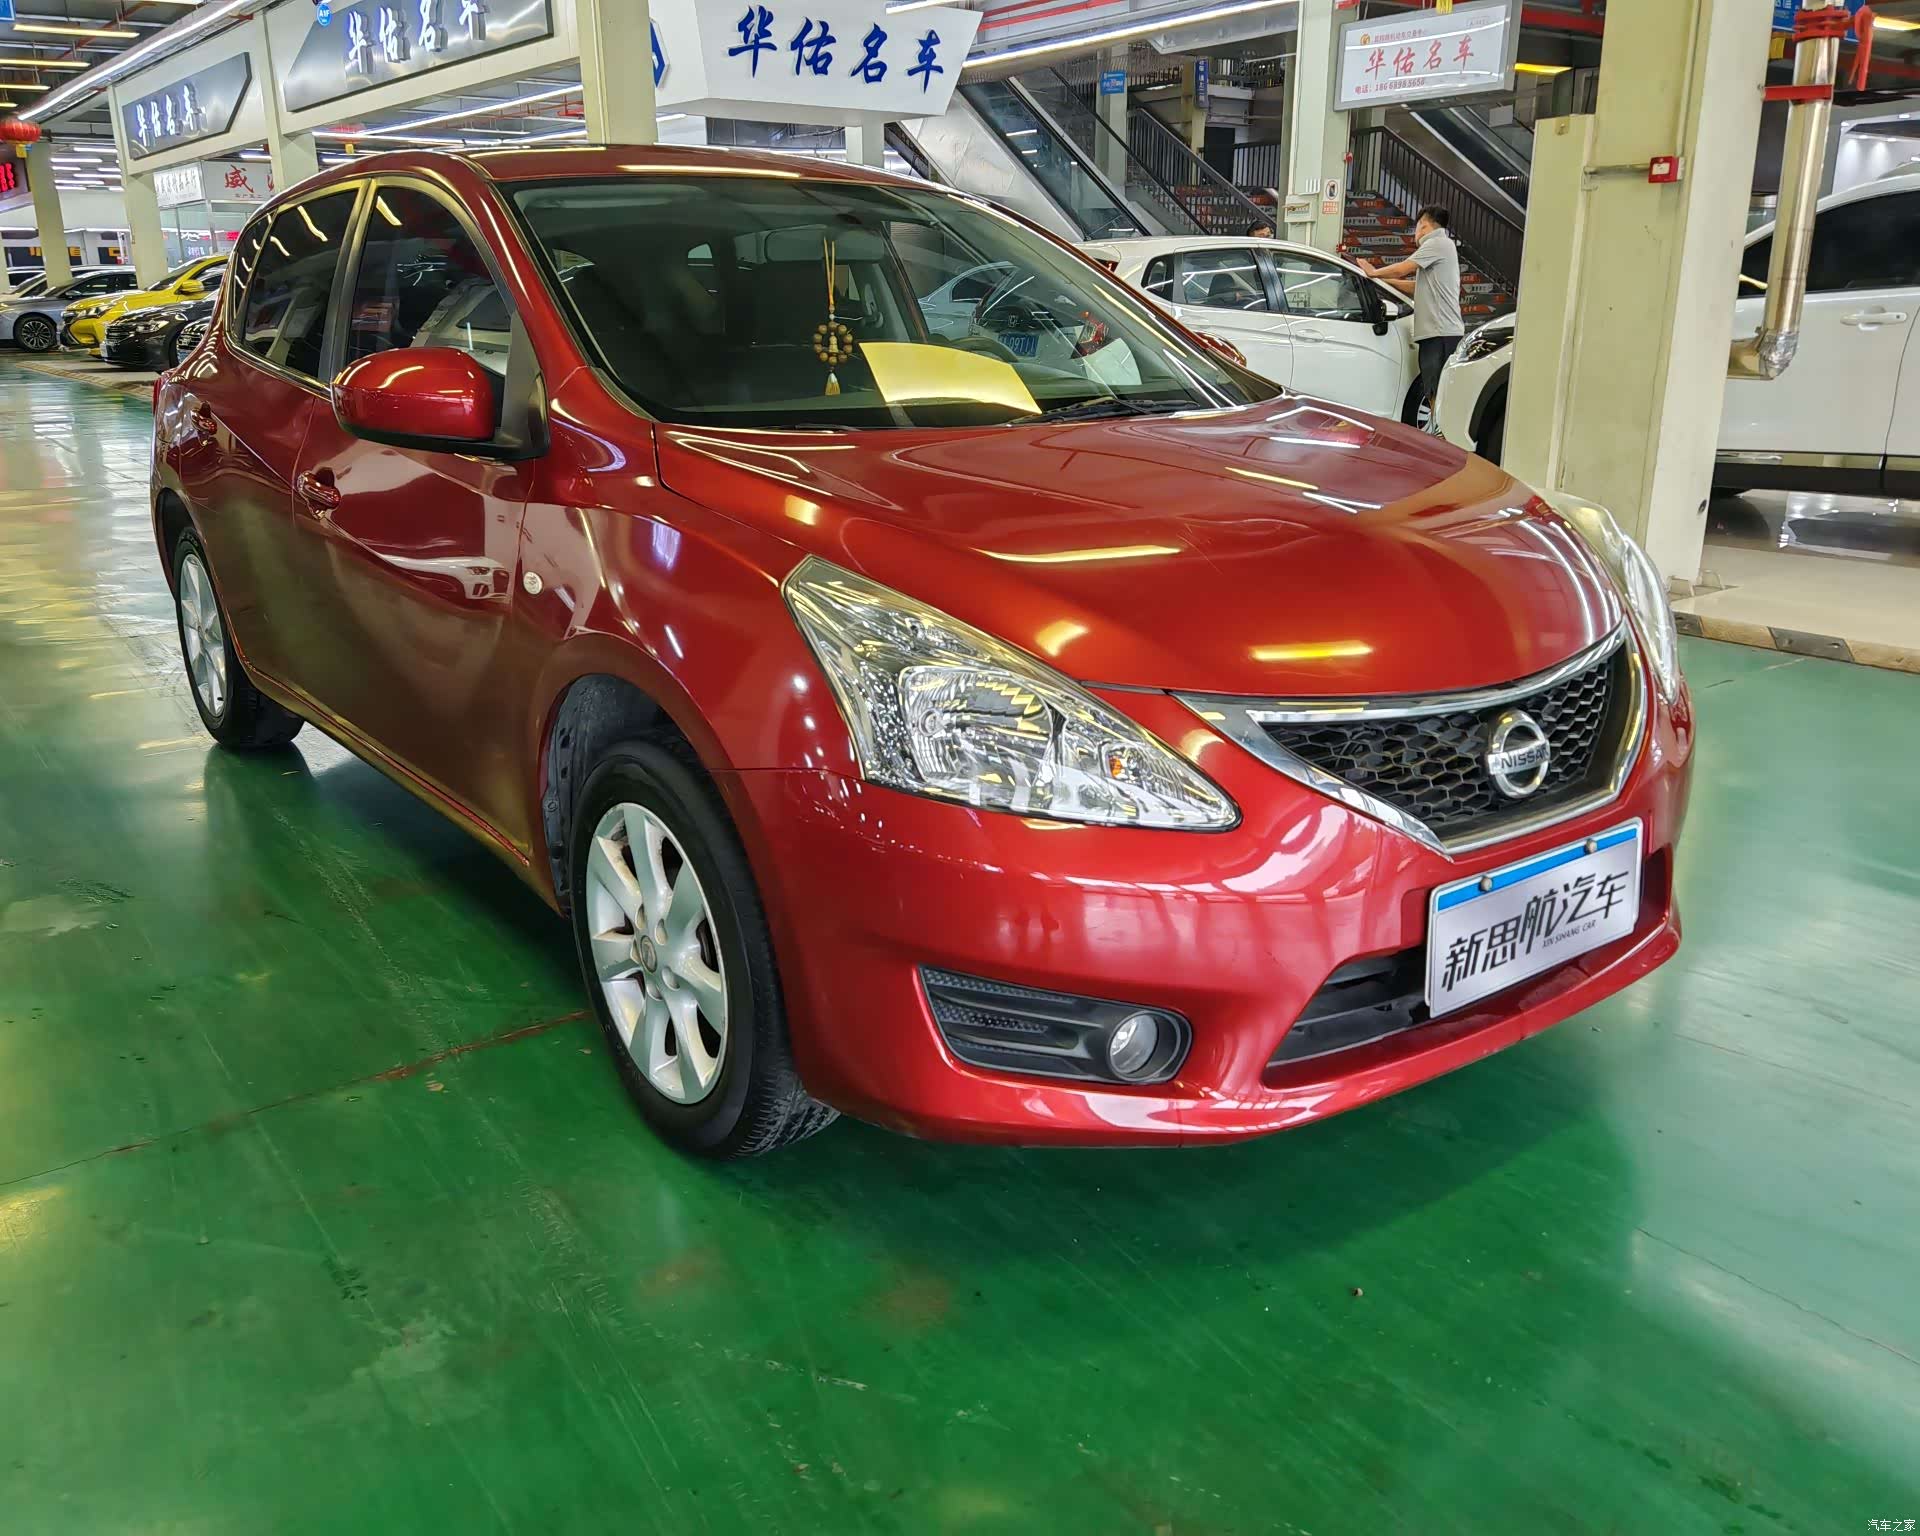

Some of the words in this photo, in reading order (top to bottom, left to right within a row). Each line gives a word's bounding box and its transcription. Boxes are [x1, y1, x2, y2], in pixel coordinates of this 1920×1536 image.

[728, 4, 944, 94] 华佑名车
[1365, 34, 1475, 80] 华佑名车
[136, 84, 206, 147] 华佑名车
[1500, 743, 1549, 769] NISSAN
[1441, 871, 1629, 992] 新思航汽车
